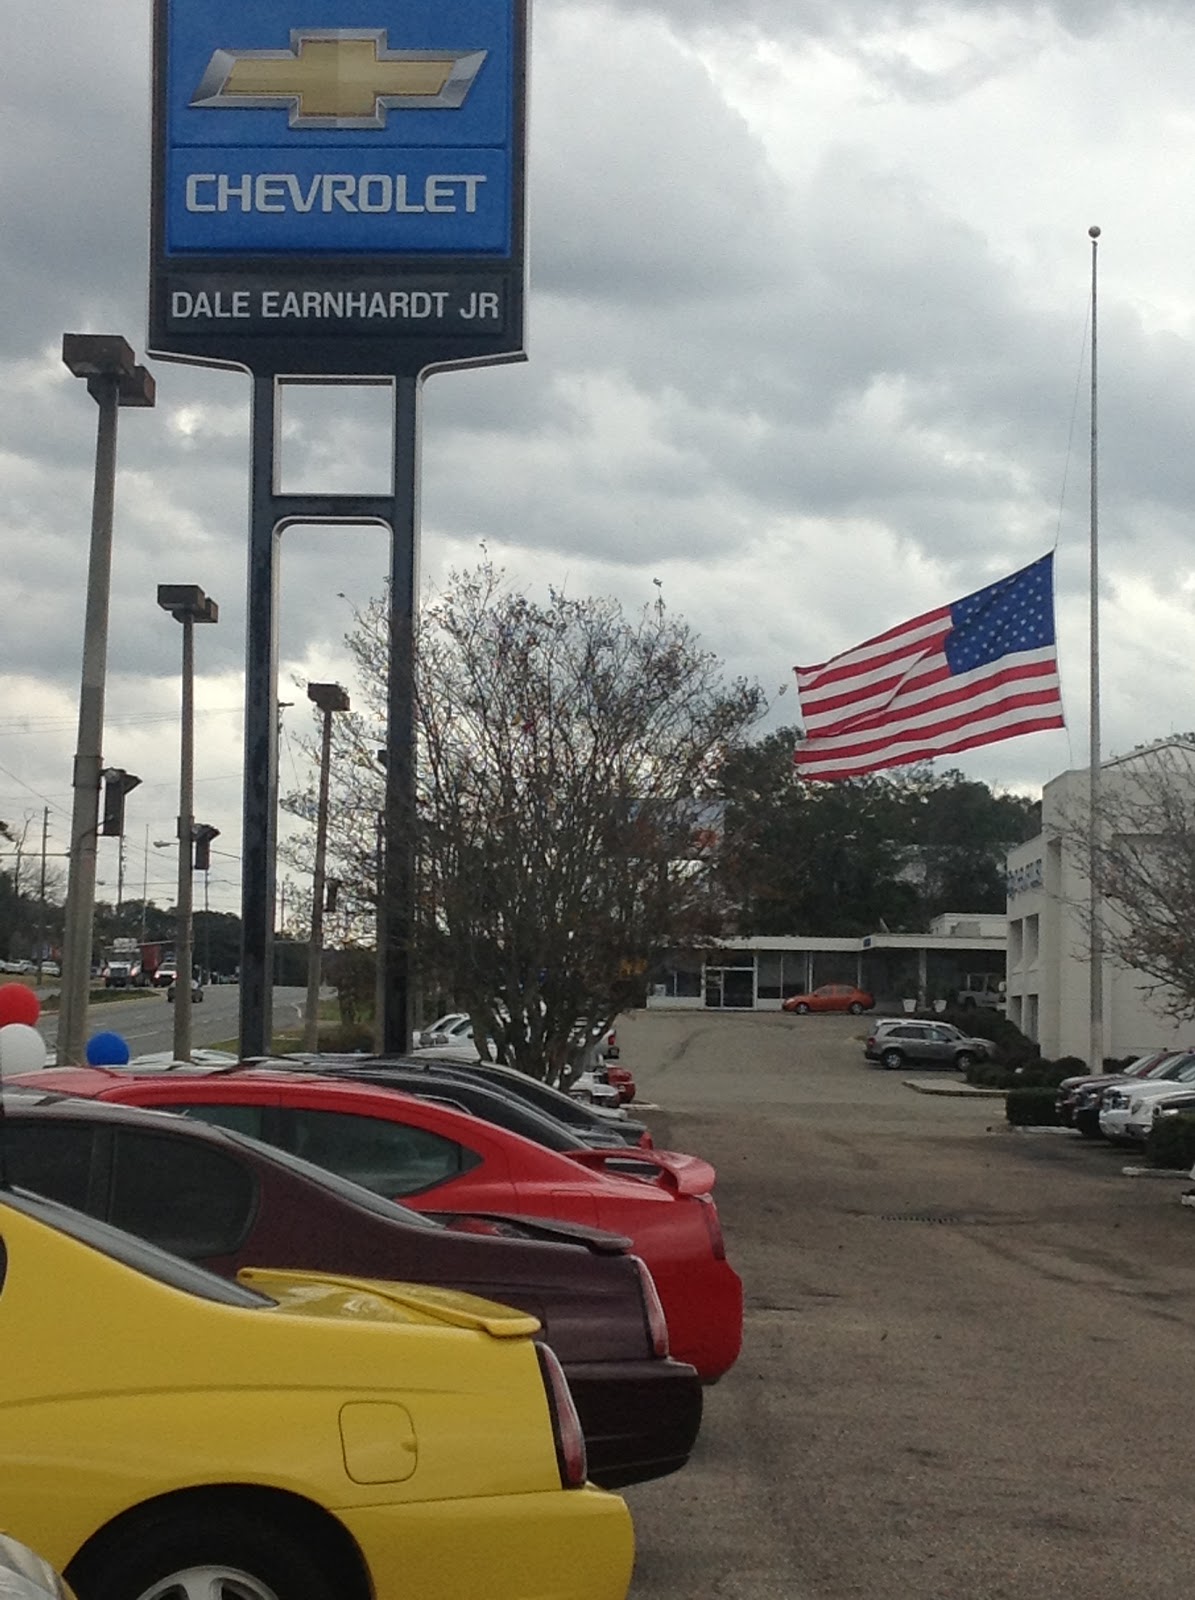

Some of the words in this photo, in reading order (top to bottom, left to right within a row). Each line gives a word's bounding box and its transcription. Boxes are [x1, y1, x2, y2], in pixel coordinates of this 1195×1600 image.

[186, 174, 487, 213] CHEVROLET
[171, 291, 251, 319] DALE
[261, 291, 449, 319] EARNHARDT
[459, 291, 499, 319] JR
